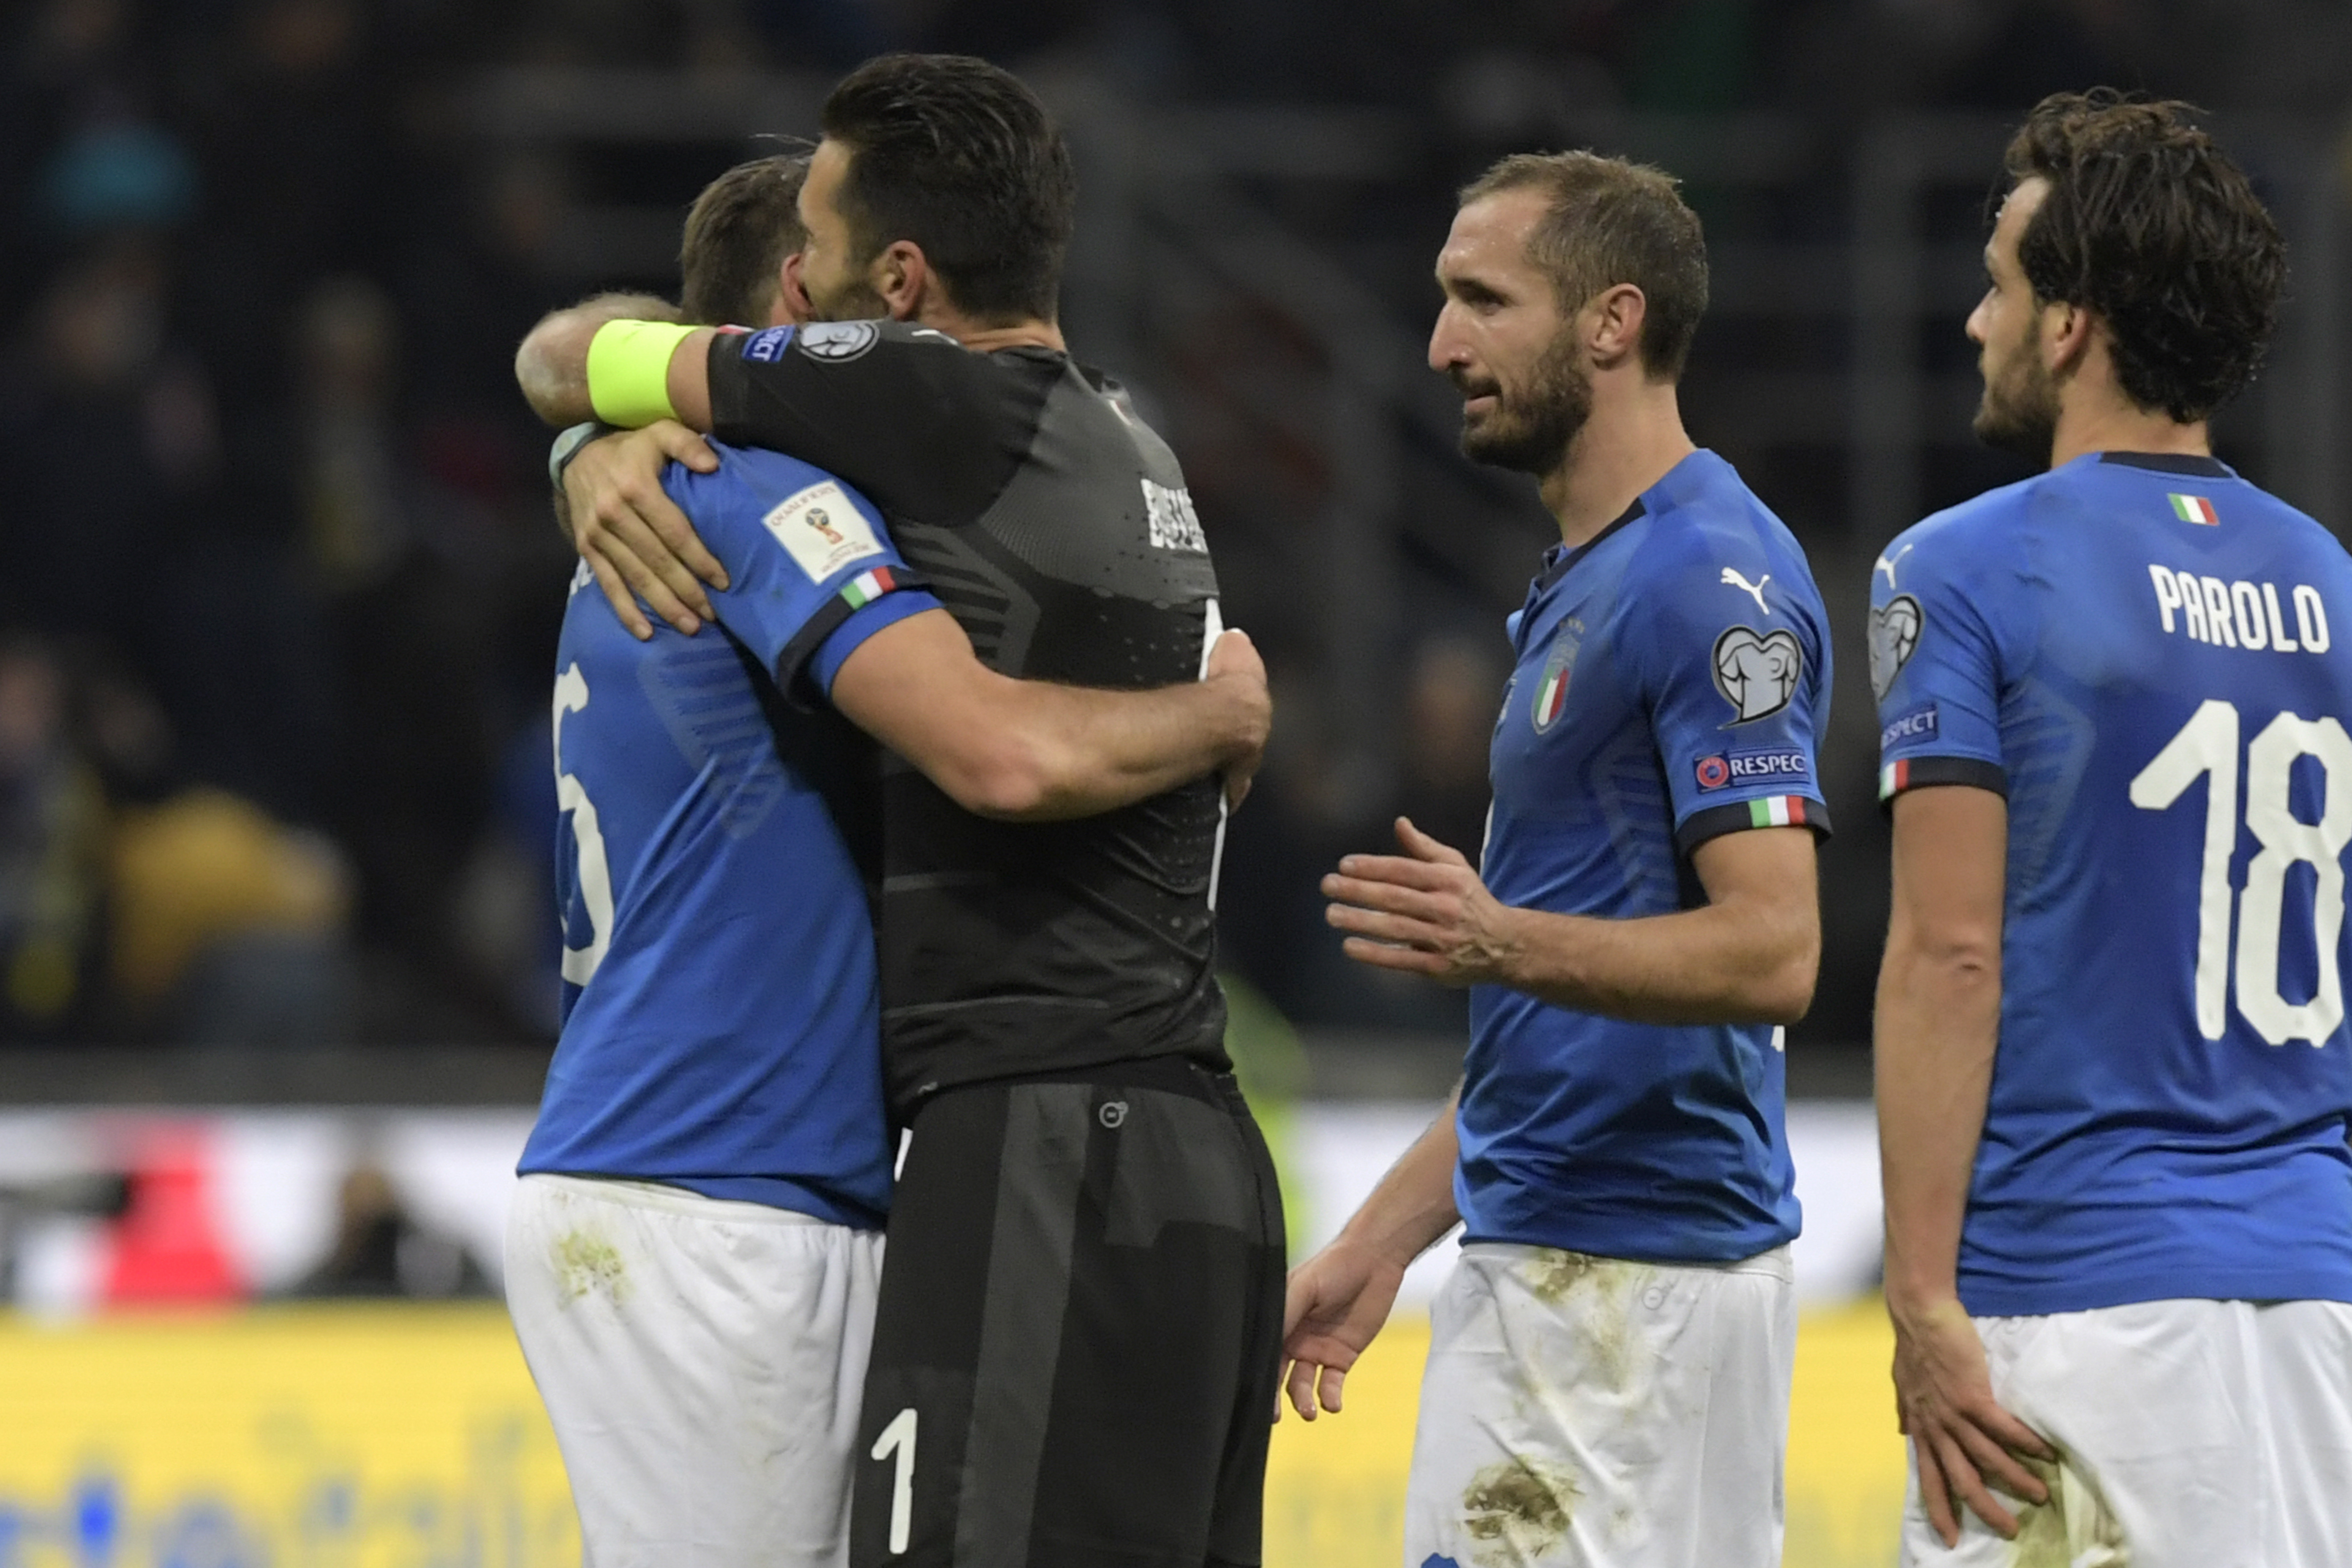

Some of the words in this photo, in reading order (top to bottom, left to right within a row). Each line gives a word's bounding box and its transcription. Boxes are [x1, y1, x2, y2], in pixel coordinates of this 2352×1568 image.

[2148, 564, 2330, 653] PAROLO
[1731, 754, 1806, 776] RESPEC
[2129, 699, 2352, 1048] 18
[871, 1408, 917, 1554] 1
